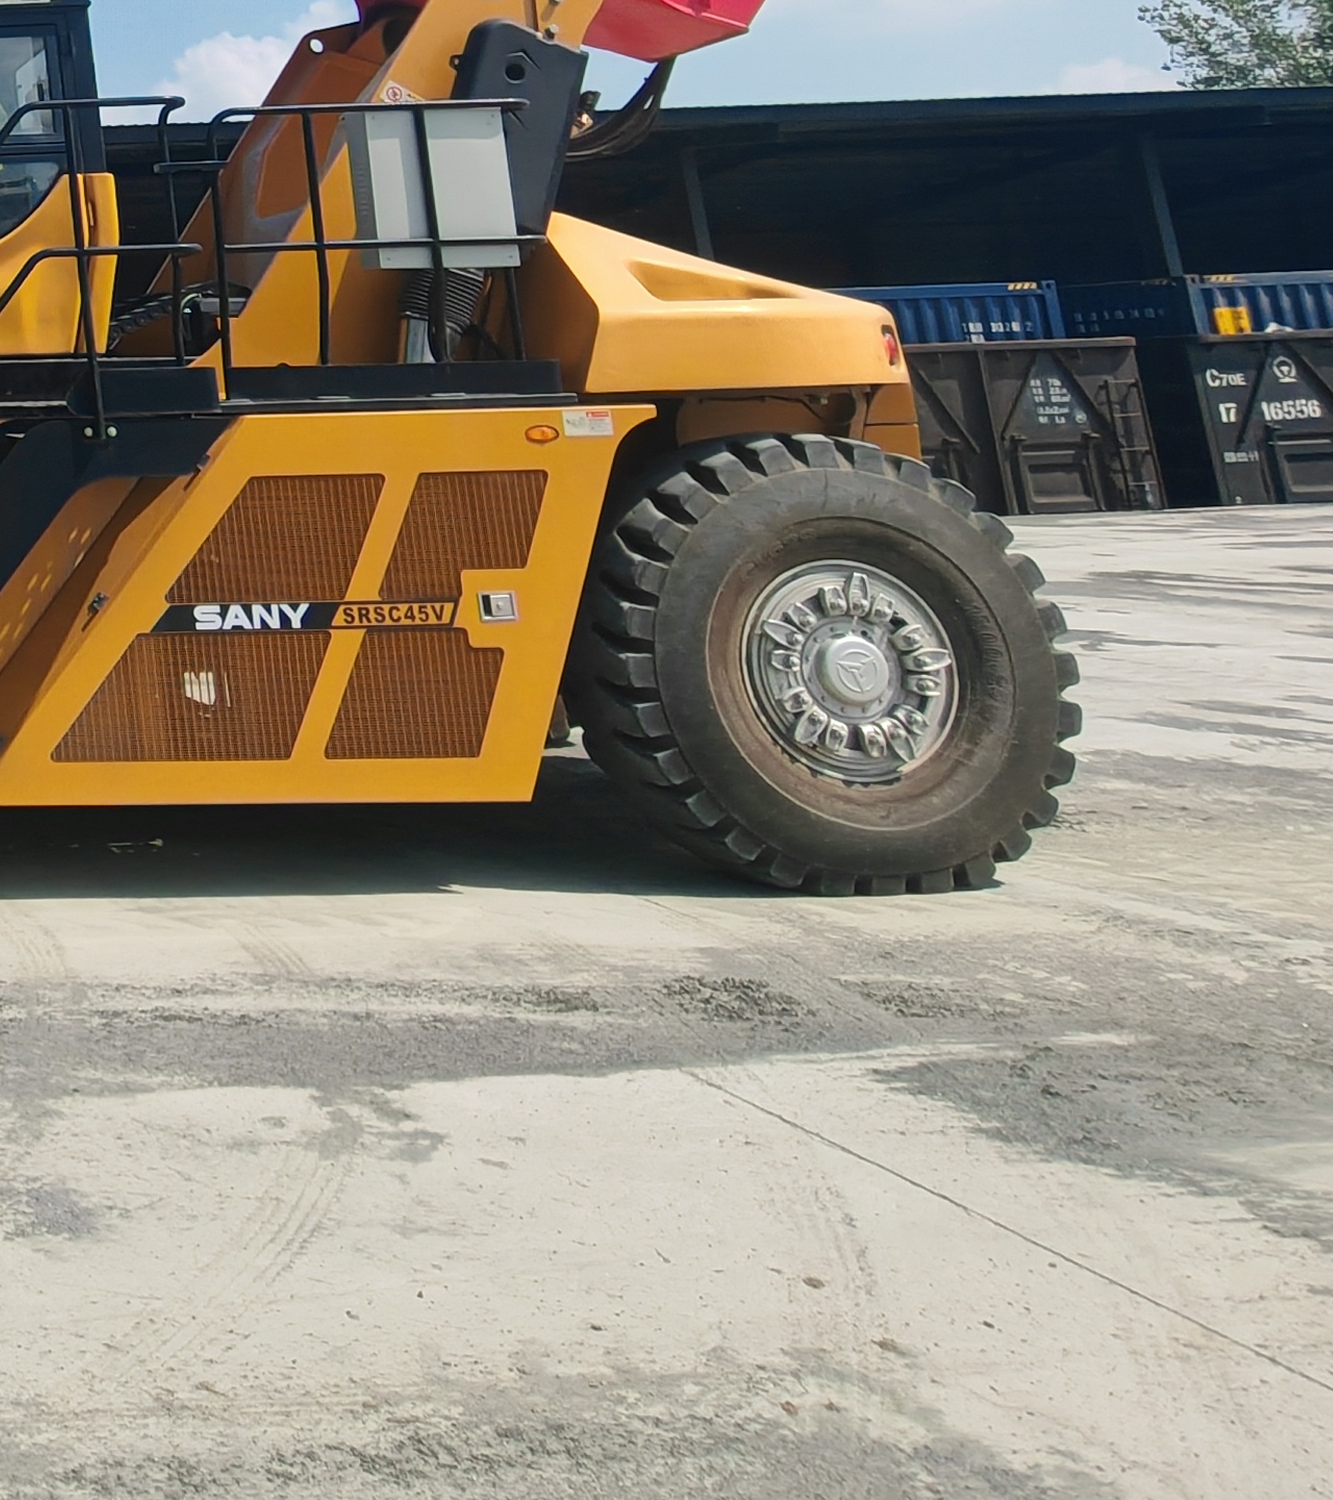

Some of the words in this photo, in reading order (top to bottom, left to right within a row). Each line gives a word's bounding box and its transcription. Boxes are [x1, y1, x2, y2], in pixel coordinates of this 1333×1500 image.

[1206, 368, 1247, 387] C70E
[1261, 399, 1321, 421] 16556
[193, 603, 310, 631] SANY
[342, 603, 447, 627] SRSC45V
